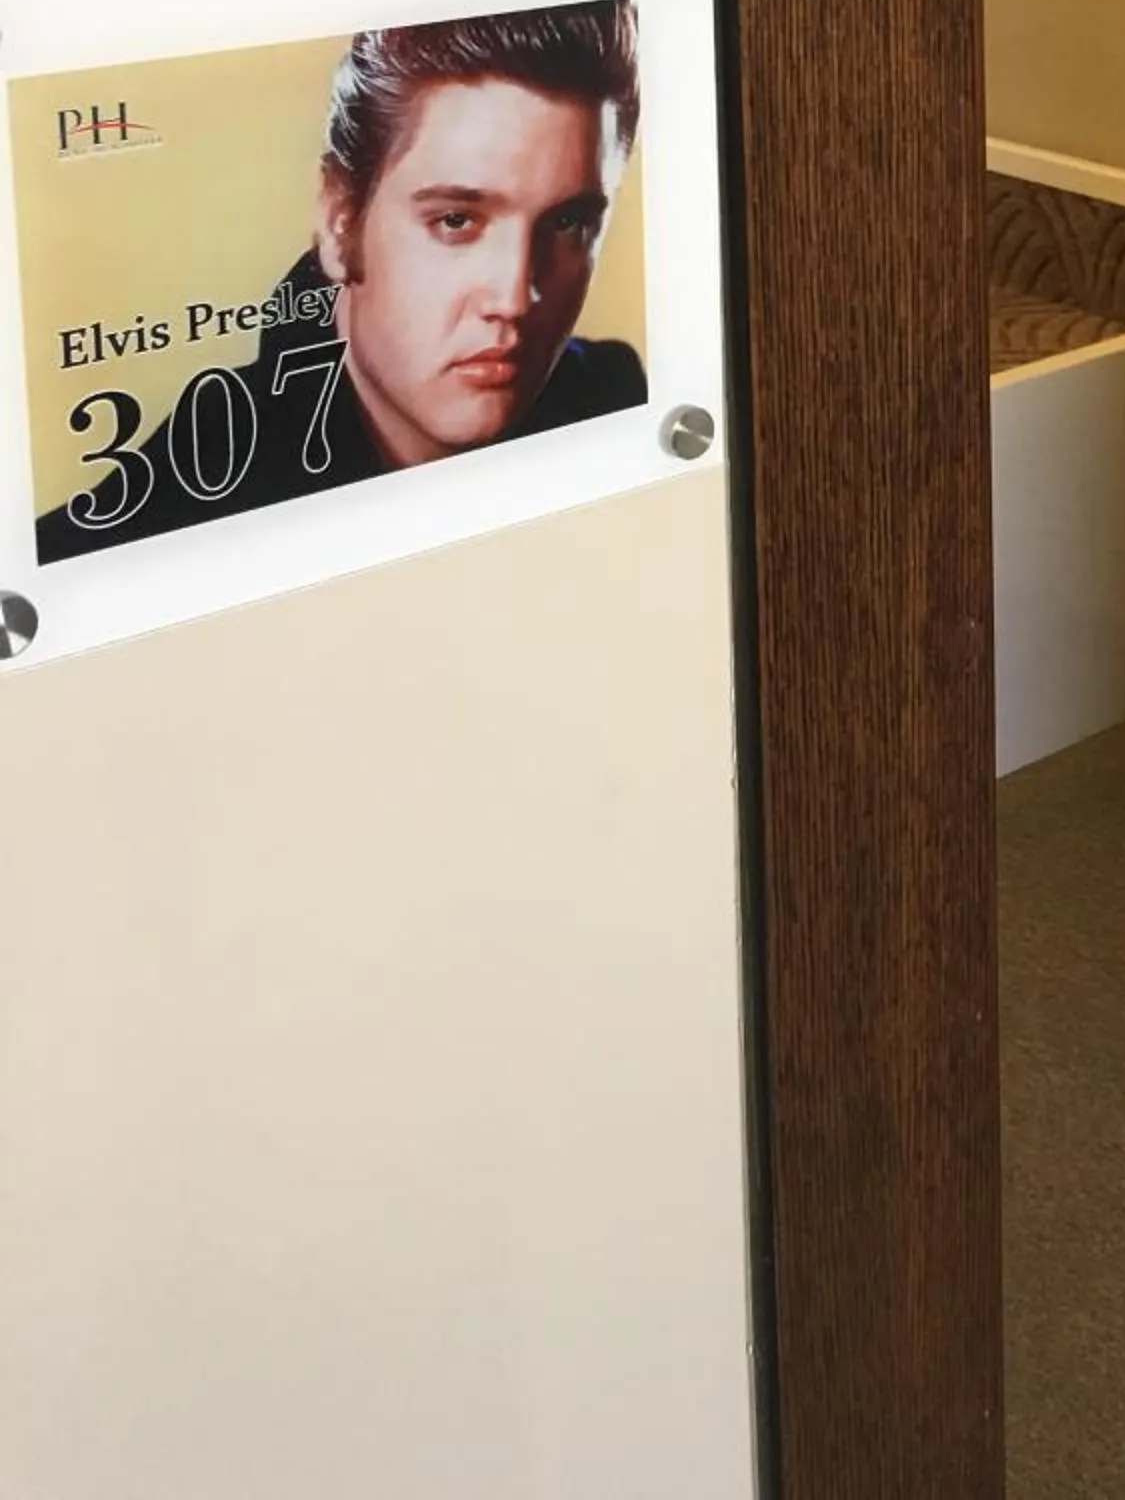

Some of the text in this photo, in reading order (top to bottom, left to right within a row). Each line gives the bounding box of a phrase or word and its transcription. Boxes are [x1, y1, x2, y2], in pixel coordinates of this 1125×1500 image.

[58, 102, 128, 150] PH
[59, 282, 344, 369] Elvis Presley
[67, 340, 349, 529] 307
